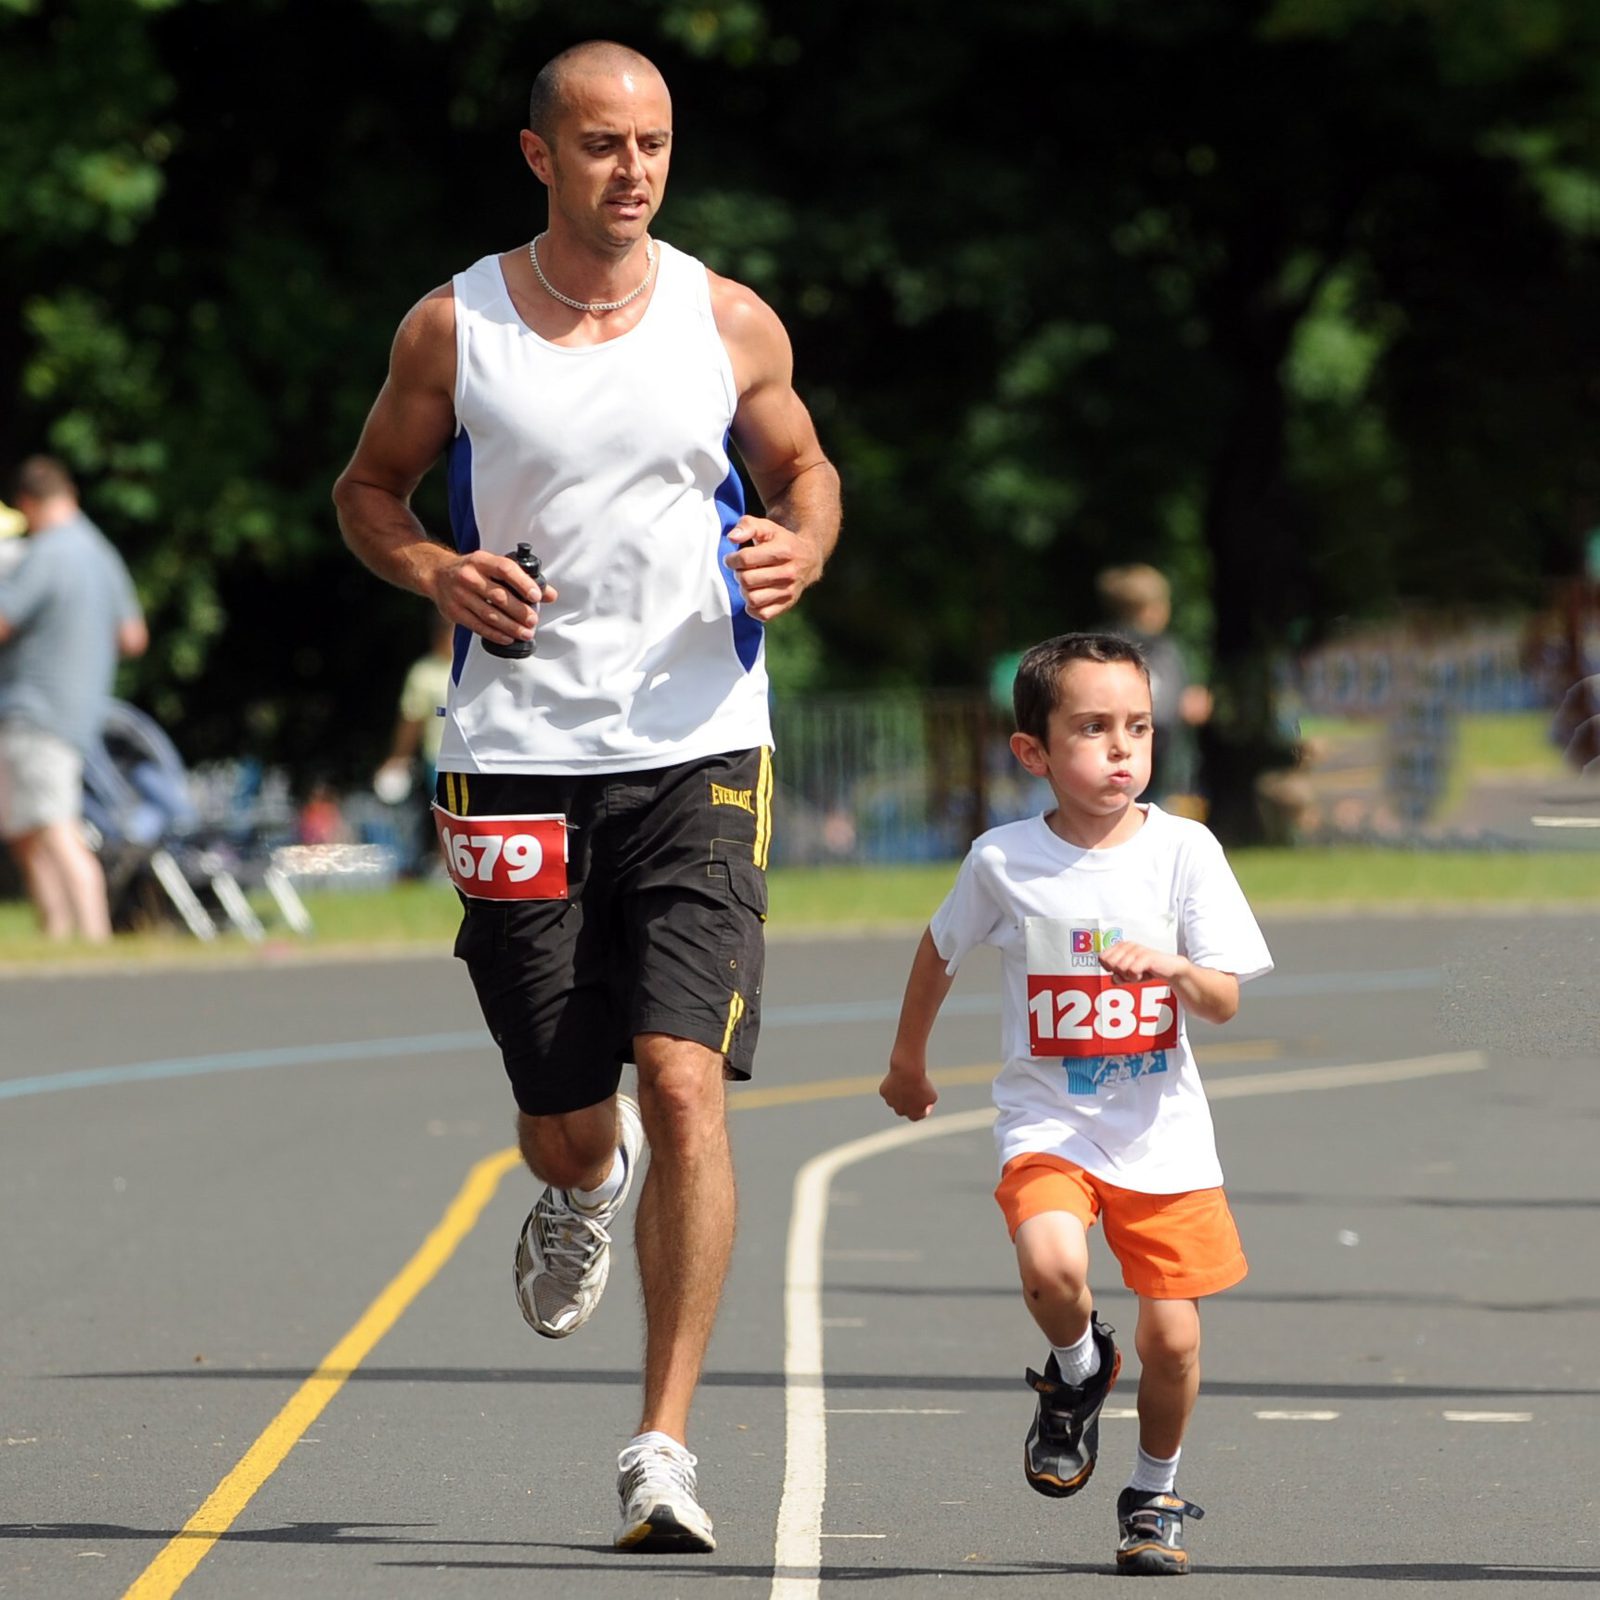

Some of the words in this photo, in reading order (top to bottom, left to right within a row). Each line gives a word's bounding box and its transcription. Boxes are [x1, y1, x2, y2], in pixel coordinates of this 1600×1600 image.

[442, 827, 543, 883] 1679
[1072, 955, 1097, 968] FUN
[1029, 986, 1174, 1040] 1285
